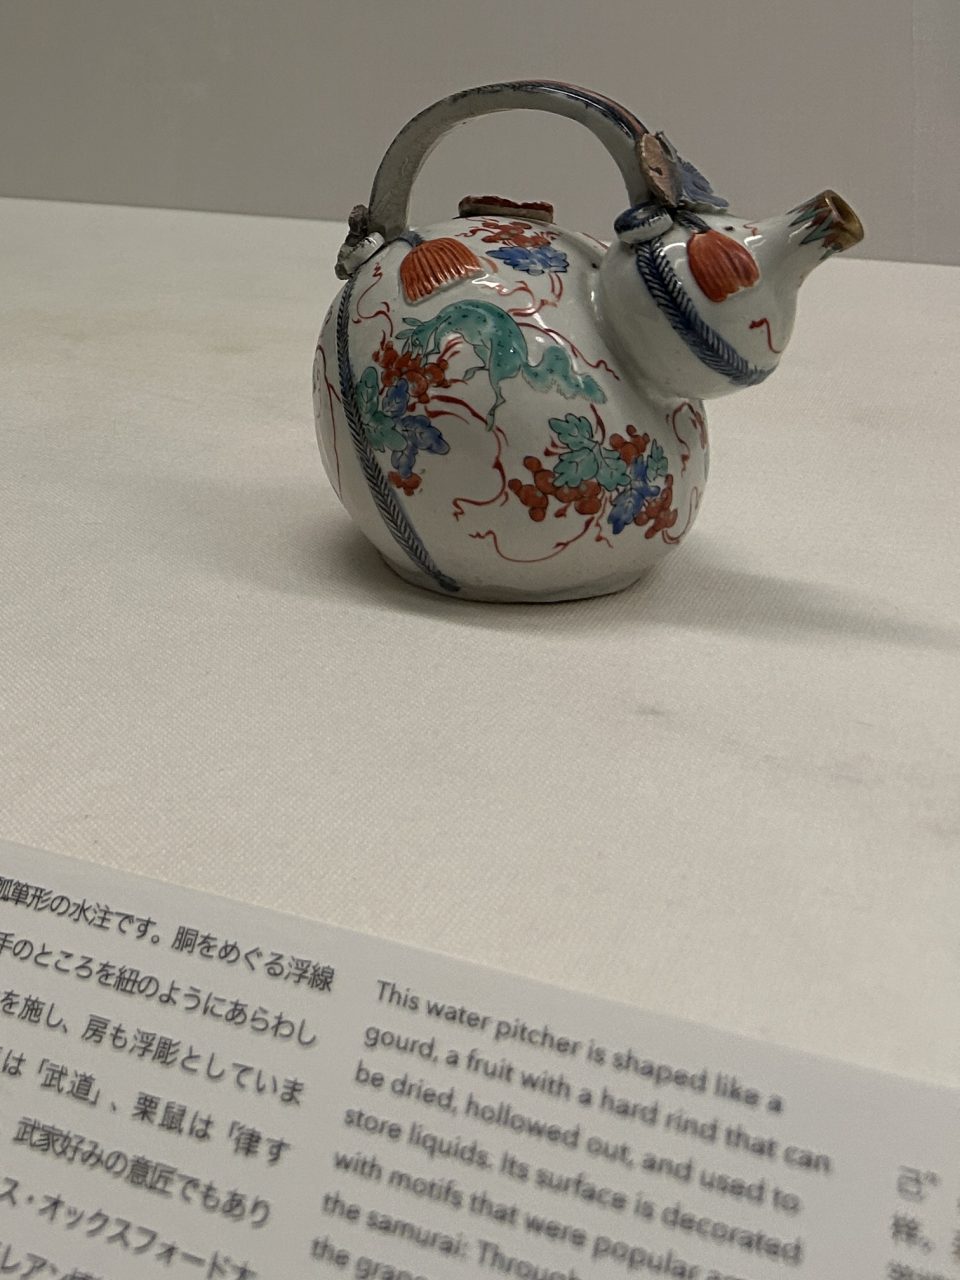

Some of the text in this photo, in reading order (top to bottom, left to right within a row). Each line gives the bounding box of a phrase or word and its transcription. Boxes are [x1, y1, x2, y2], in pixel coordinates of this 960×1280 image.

[363, 1025, 833, 1175] gourd, a fruit with a hard rind that can
[376, 979, 785, 1116] This water pitcher is shaped like a
[333, 1149, 384, 1183] with
[388, 1168, 465, 1210] motifs
[468, 1188, 520, 1226] that
[523, 1211, 588, 1249] were
[343, 1106, 805, 1268] store liquids. Its surface is decorated
[354, 1057, 385, 1089] be
[390, 1072, 459, 1117] dried,
[464, 1091, 581, 1150] hollowed
[641, 1152, 693, 1185] and
[699, 1168, 766, 1207] used
[771, 1186, 803, 1217] to
[310, 1235, 352, 1269] the
[321, 1189, 361, 1224] the
